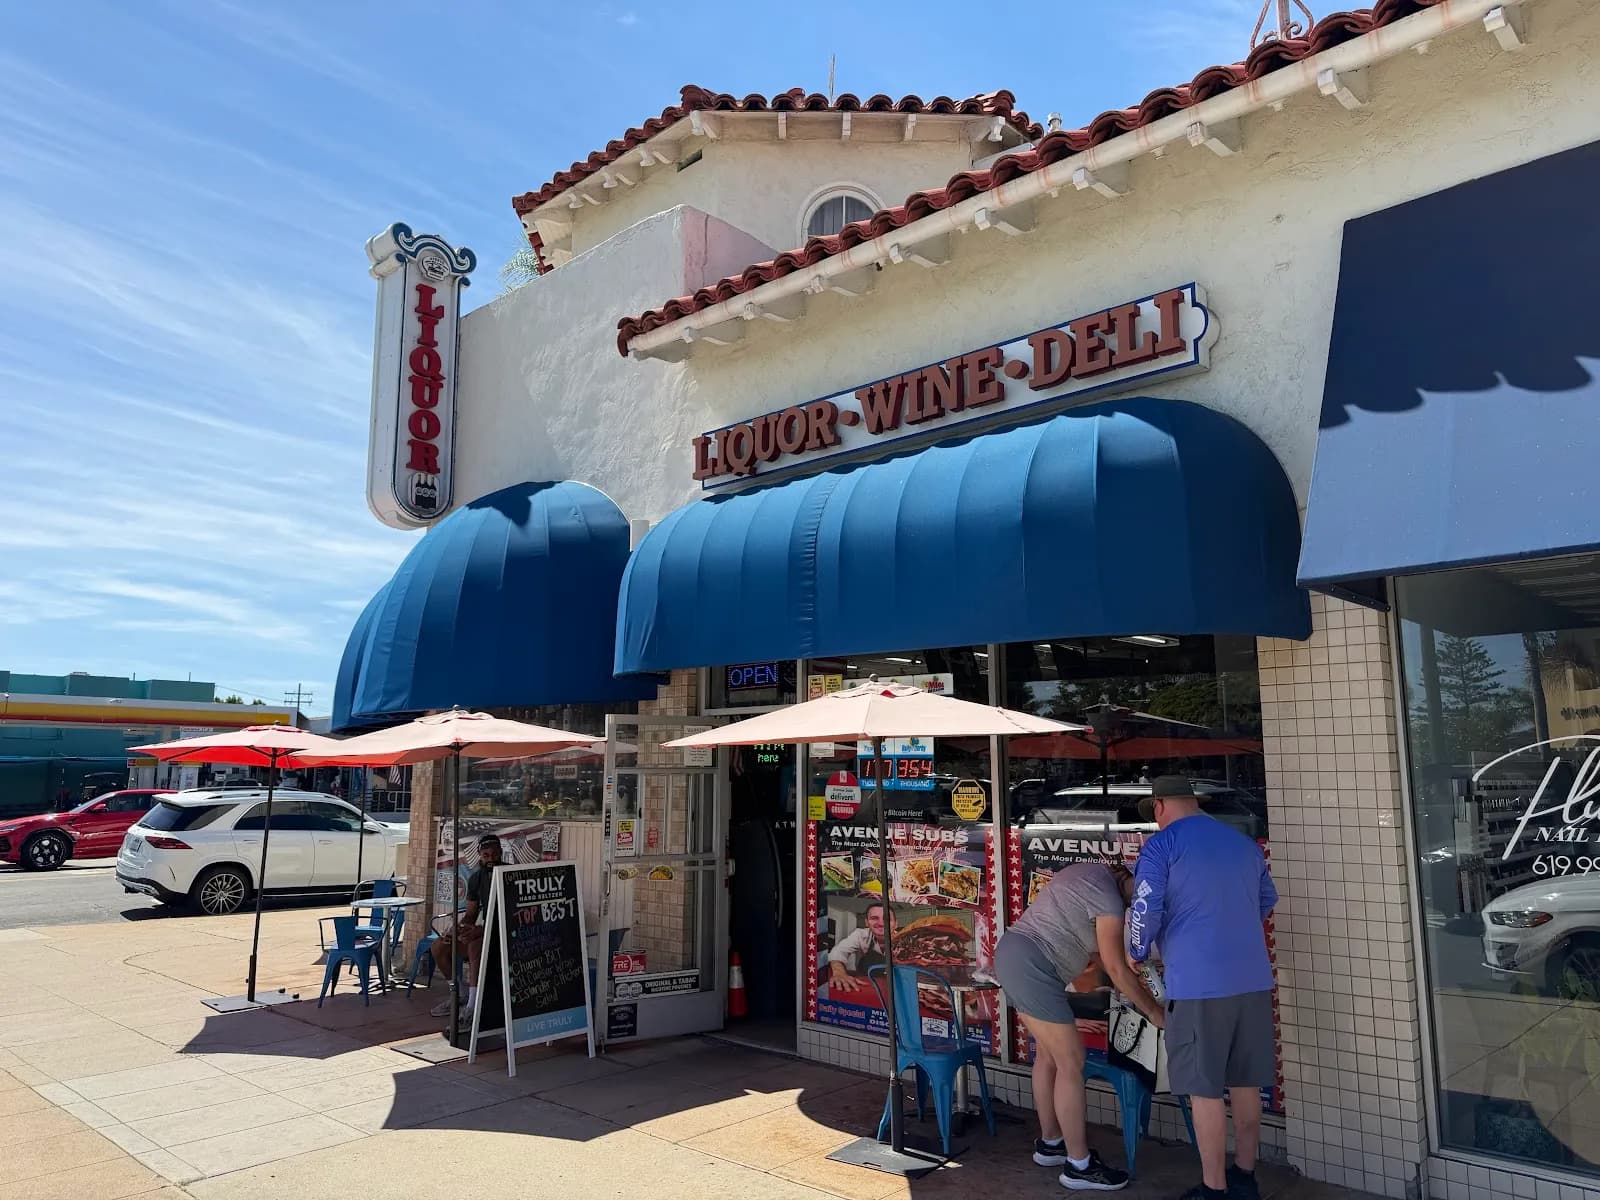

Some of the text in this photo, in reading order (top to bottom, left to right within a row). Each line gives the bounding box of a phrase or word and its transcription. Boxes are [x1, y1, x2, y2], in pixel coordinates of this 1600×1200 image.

[407, 283, 446, 474] LIQUOR
[692, 288, 1187, 481] LIQUOR WINE DELI
[730, 666, 777, 686] OPEN
[898, 760, 932, 778] 354
[912, 829, 968, 845] SUBS
[1533, 826, 1589, 843] NAIL
[1028, 838, 1139, 856] AVENUE
[1075, 857, 1118, 865] Delicious
[514, 875, 565, 895] TRULY
[541, 897, 576, 922] BEST
[548, 1015, 573, 1028] TRULY
